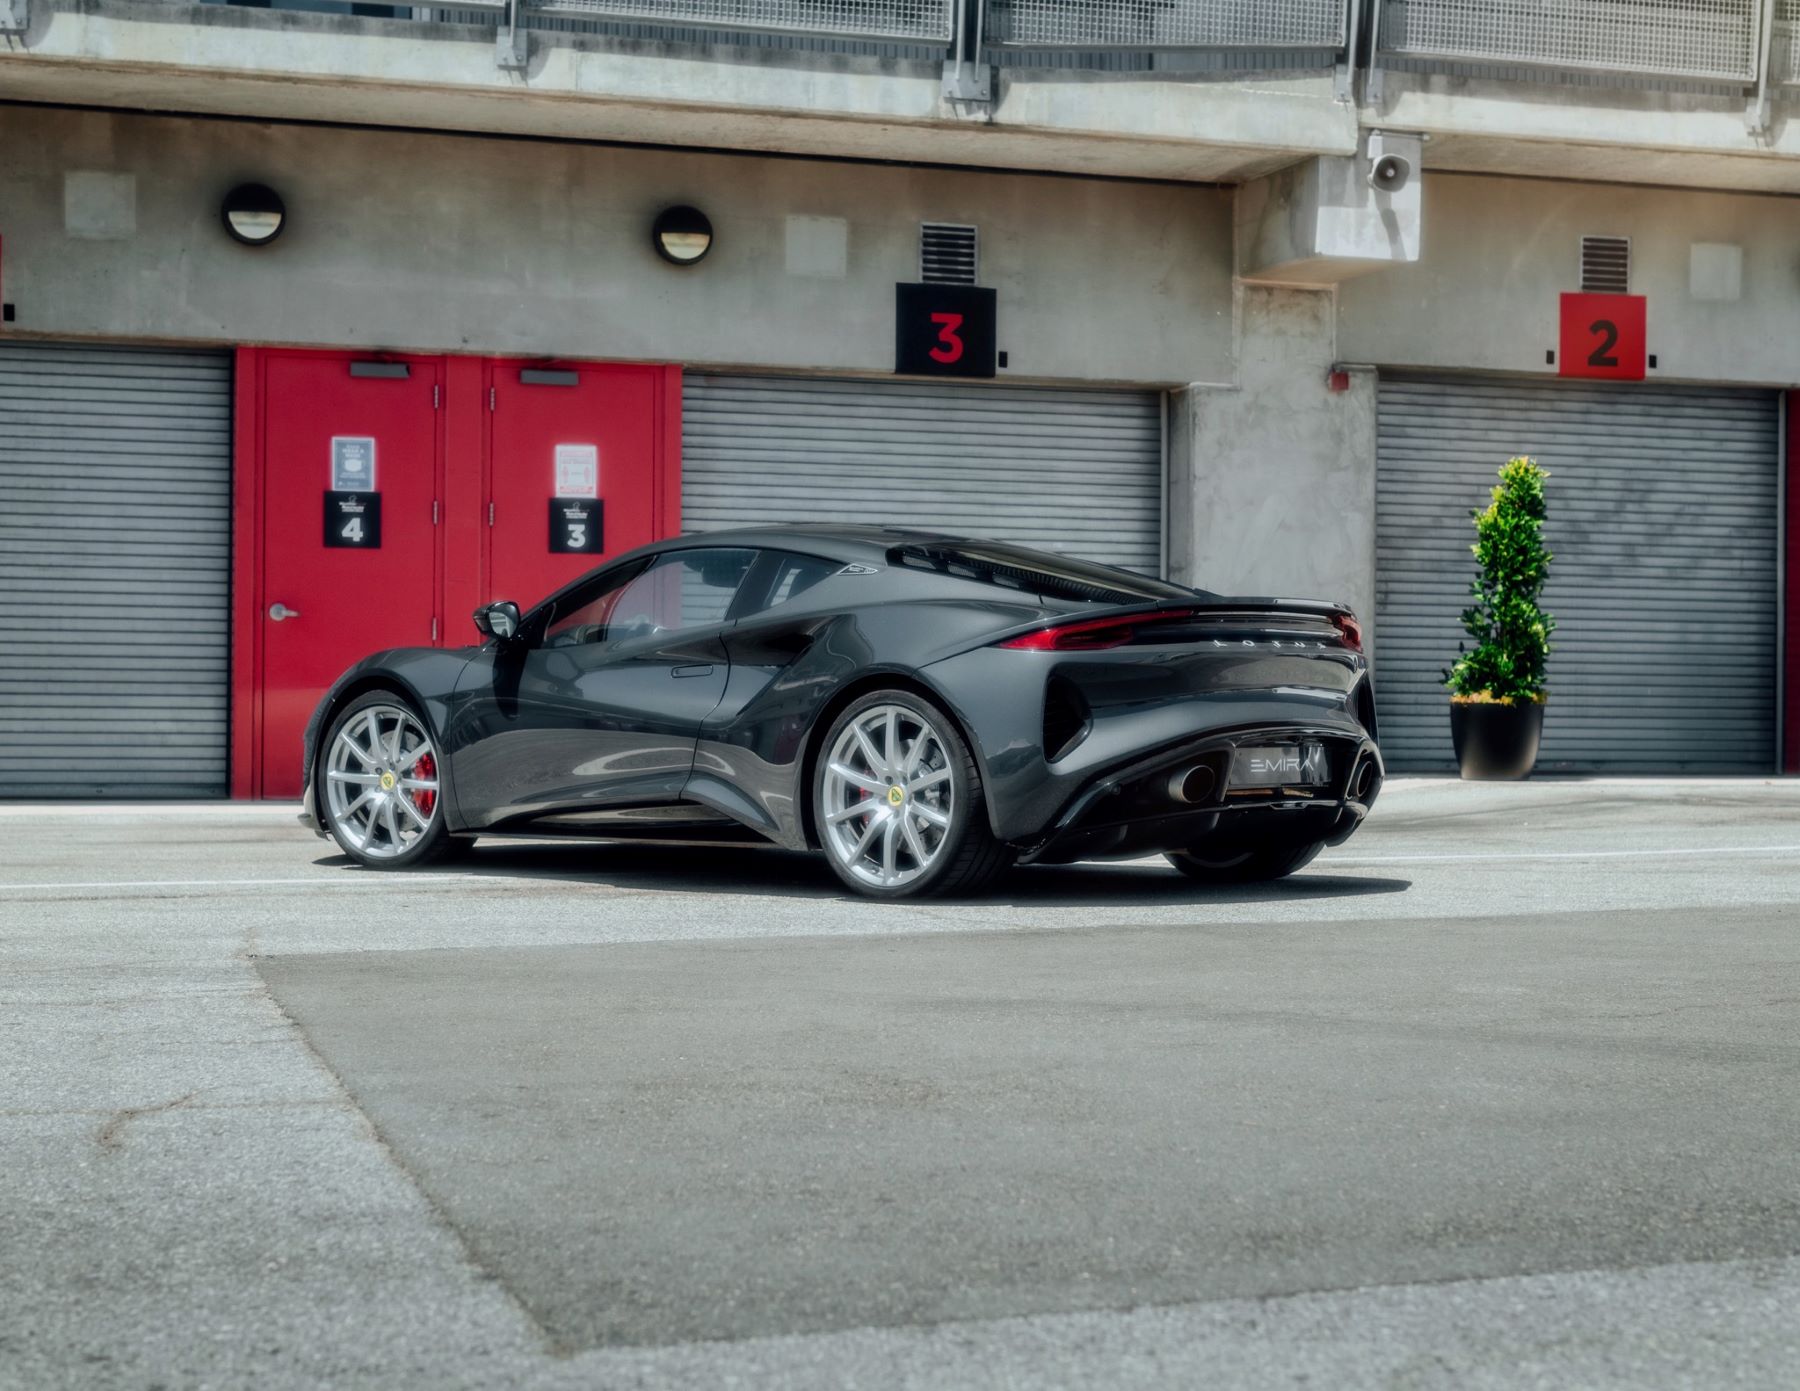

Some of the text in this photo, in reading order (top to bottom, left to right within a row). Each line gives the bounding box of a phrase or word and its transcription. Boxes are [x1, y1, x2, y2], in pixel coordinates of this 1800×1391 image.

[928, 312, 965, 365] 3
[1587, 319, 1619, 367] 2
[341, 517, 364, 542] 4
[567, 523, 586, 548] 3
[1250, 758, 1314, 773] EMIRA
